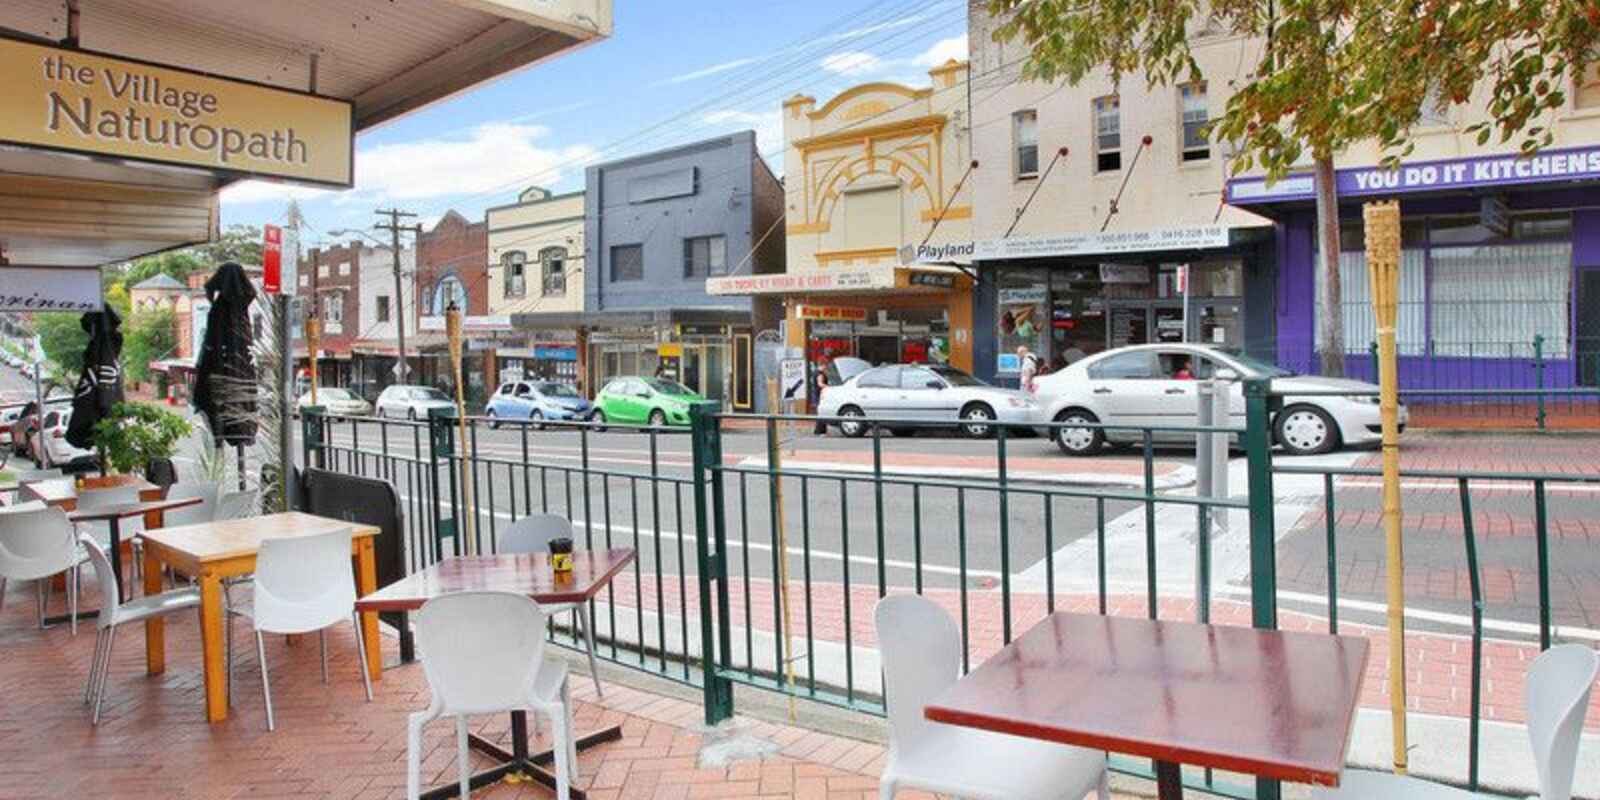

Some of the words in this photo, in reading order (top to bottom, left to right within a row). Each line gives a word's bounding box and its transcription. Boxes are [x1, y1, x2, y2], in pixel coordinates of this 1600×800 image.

[43, 56, 95, 85] the
[104, 68, 218, 118] Village
[48, 91, 308, 163] Naturopath
[1355, 171, 1399, 190] YOU
[1405, 167, 1437, 186] DO
[1443, 164, 1467, 183] IT
[1473, 152, 1600, 181] KITCHENS
[917, 241, 976, 260] Playland
